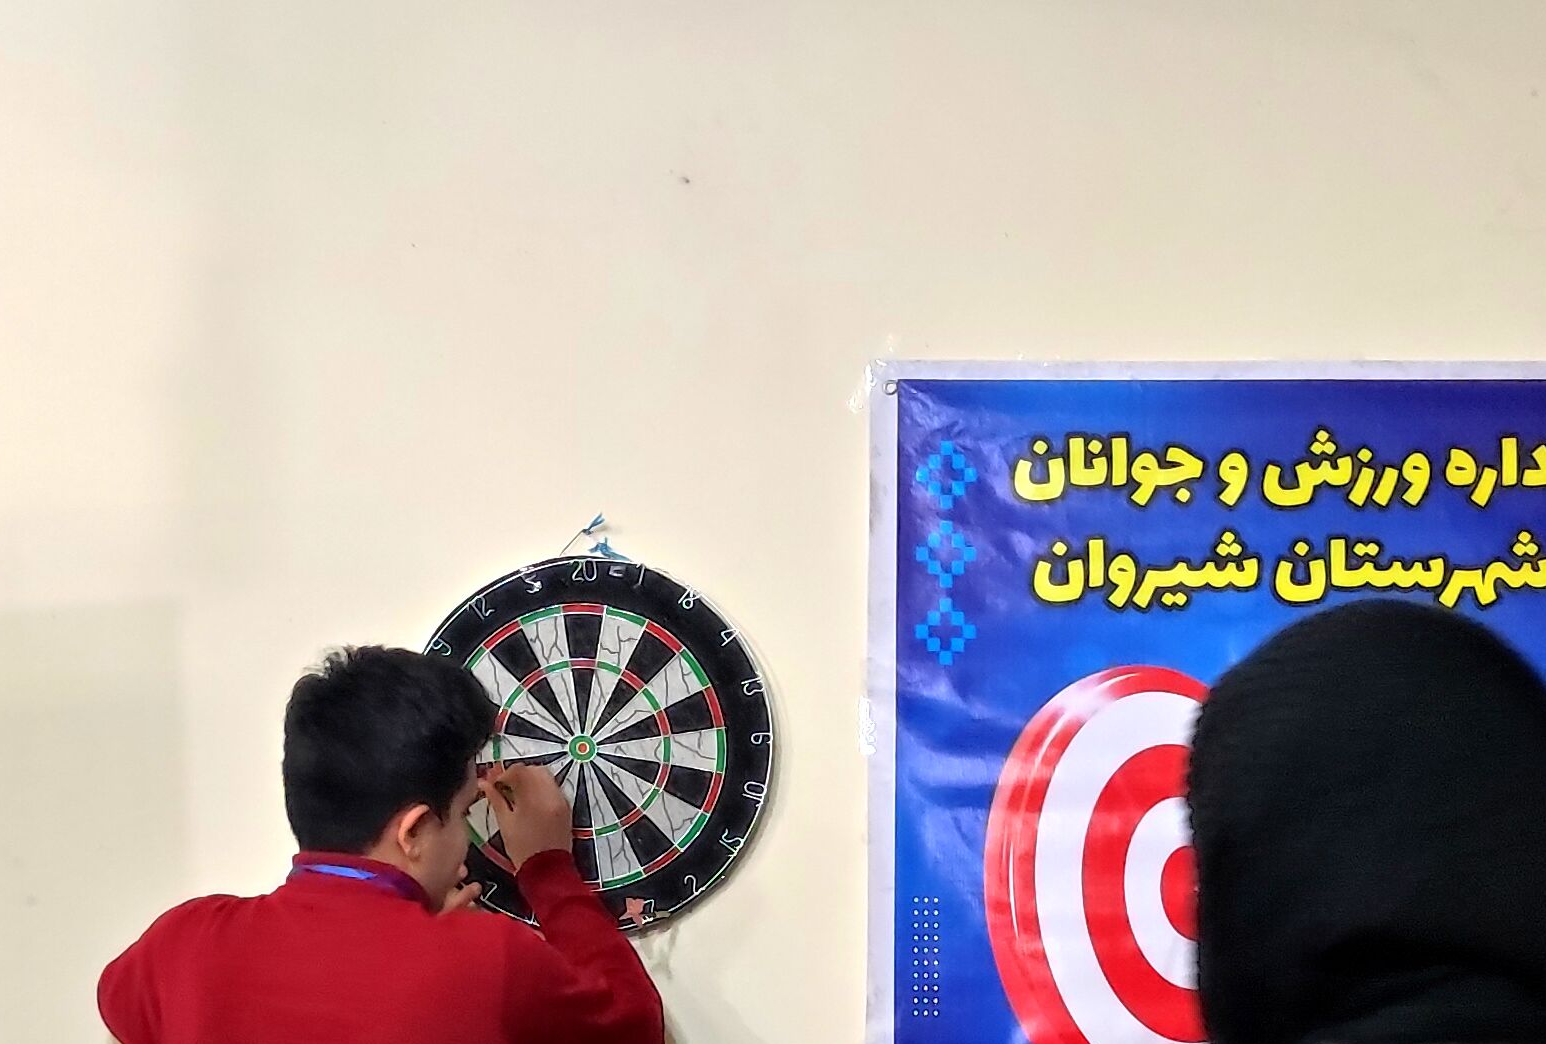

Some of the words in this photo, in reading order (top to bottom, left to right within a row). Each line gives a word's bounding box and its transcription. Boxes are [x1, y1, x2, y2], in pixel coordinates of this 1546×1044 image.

[1013, 434, 1205, 508] جوانان
[1217, 458, 1247, 508] و
[1262, 429, 1427, 508] ورزش
[520, 573, 543, 594] 5
[571, 559, 598, 582] 20
[1032, 532, 1261, 609] شیروان
[466, 595, 496, 622] 12
[678, 585, 702, 610] 18
